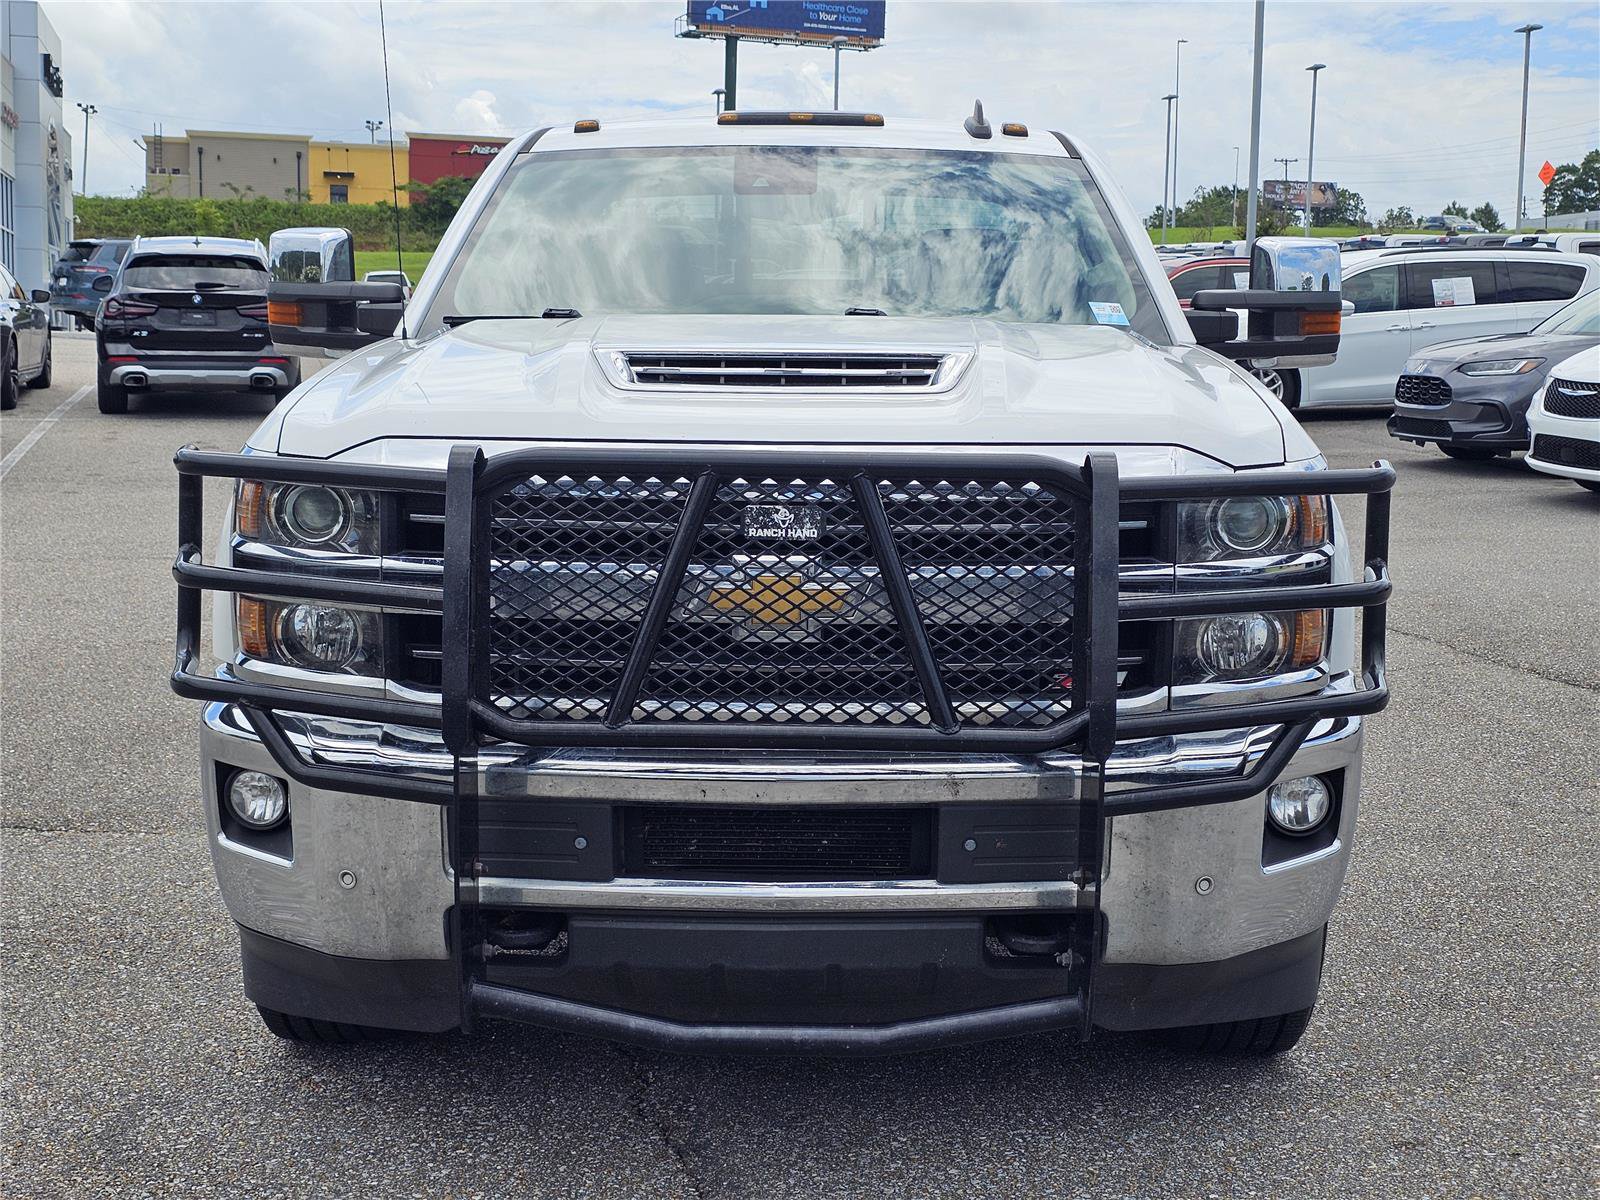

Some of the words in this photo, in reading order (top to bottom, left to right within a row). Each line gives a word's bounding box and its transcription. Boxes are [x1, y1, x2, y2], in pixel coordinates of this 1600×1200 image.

[803, 1, 845, 12] Healthcare
[846, 4, 869, 16] Close
[809, 11, 818, 20] to
[819, 11, 838, 21] Your
[839, 13, 862, 24] Home
[749, 528, 786, 537] RANCH
[787, 528, 818, 538] HAND
